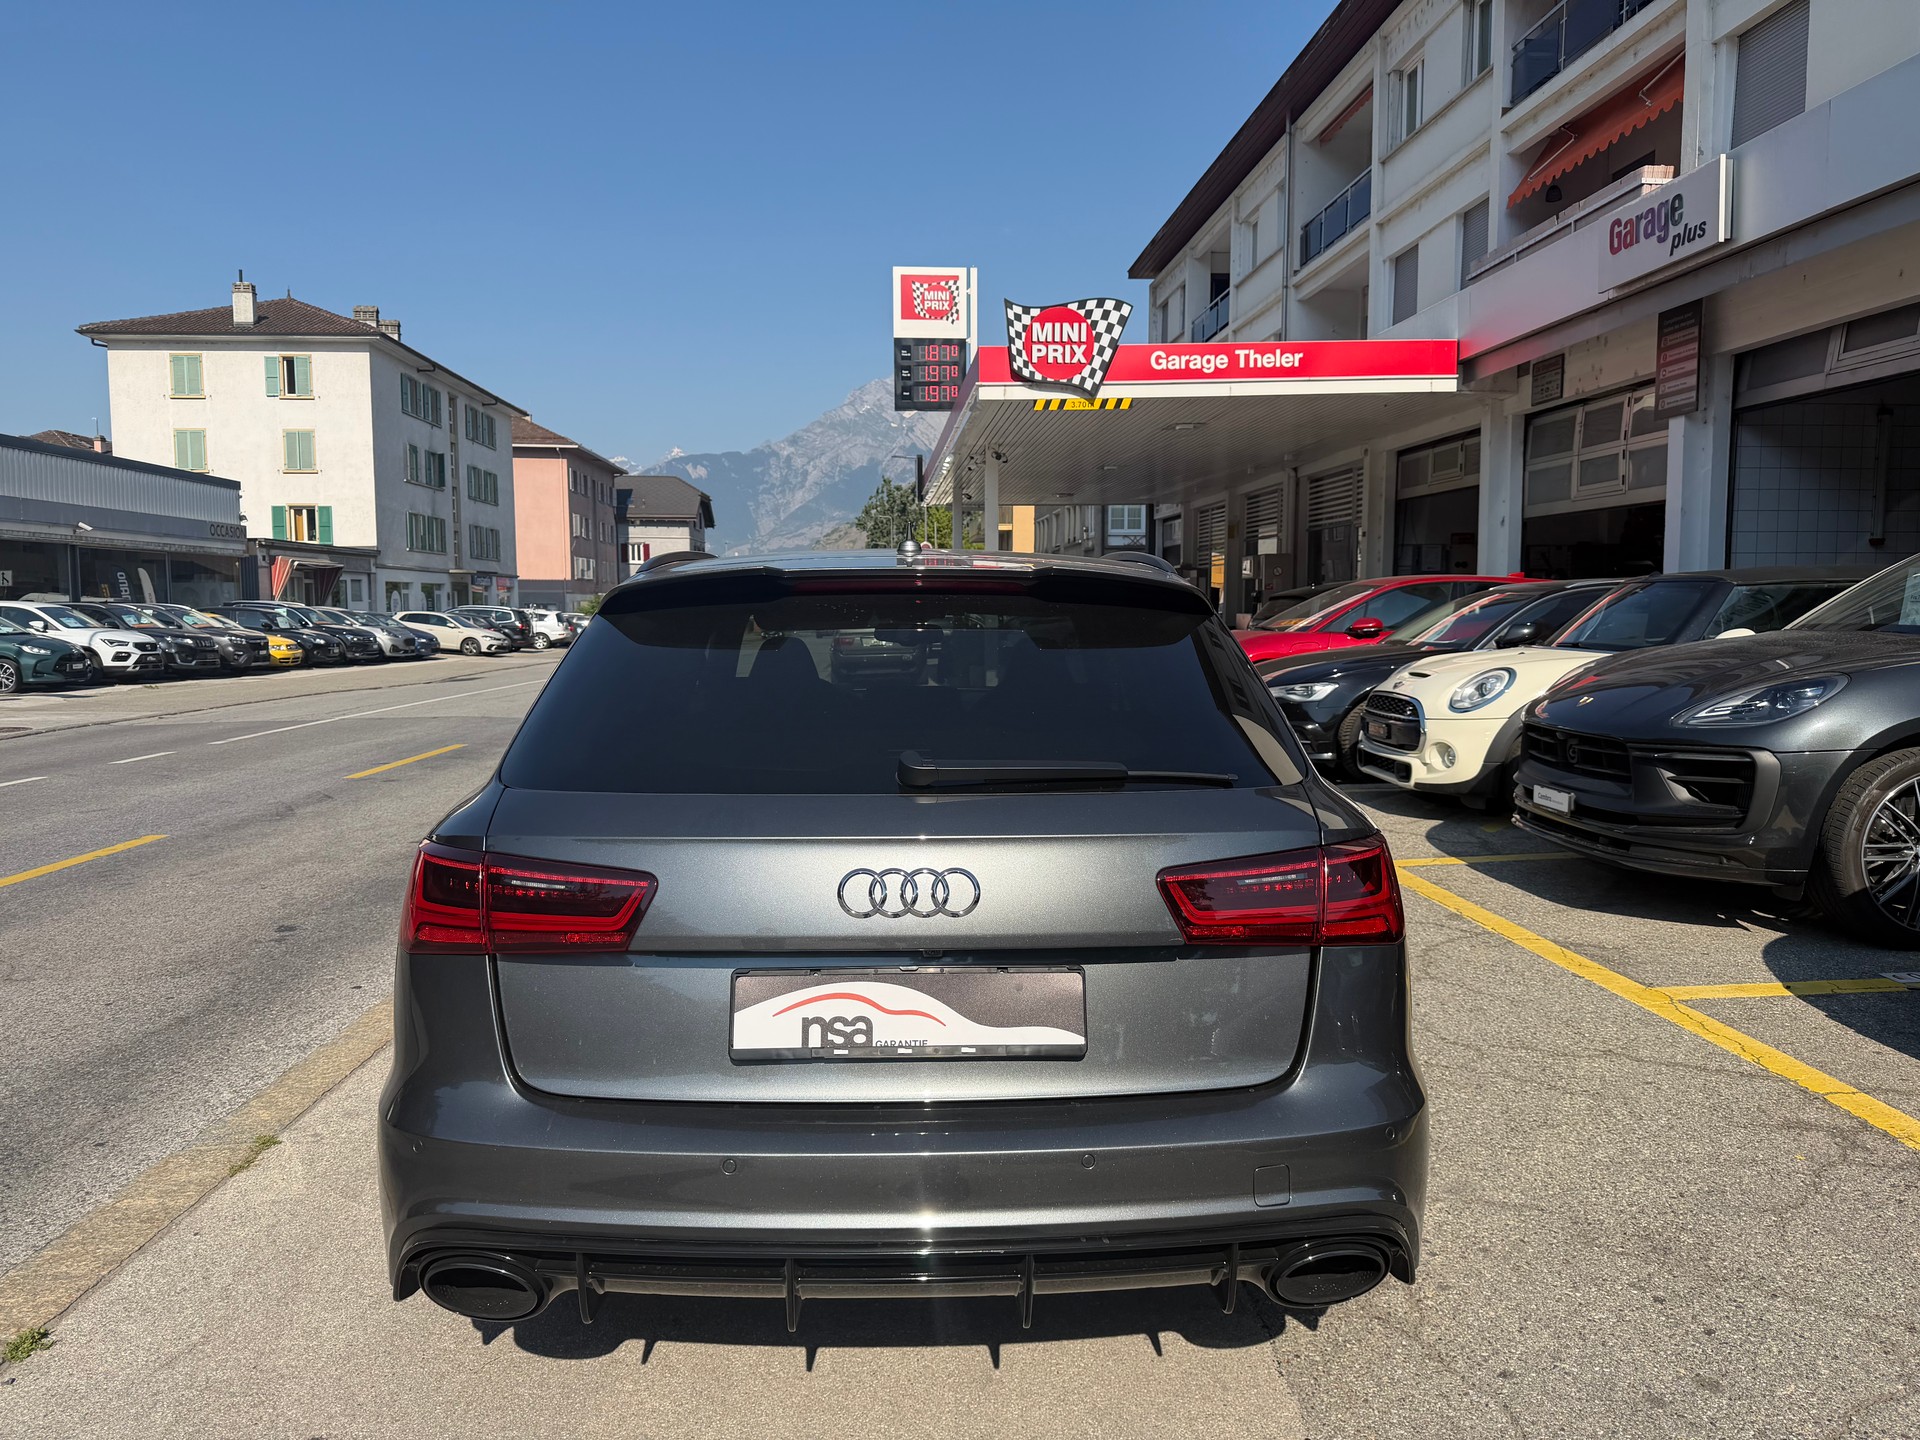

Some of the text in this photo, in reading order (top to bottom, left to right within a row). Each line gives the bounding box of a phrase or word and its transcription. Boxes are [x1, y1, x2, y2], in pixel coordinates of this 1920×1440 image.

[1609, 193, 1684, 256] Garage
[1669, 220, 1707, 257] plus
[924, 290, 950, 301] MINI
[924, 300, 950, 311] PRIX
[1032, 322, 1087, 343] MINI
[1032, 344, 1088, 365] PRIX
[1150, 349, 1303, 373] Garage Theler
[210, 523, 247, 539] OCCASION
[801, 1015, 874, 1047] nsa
